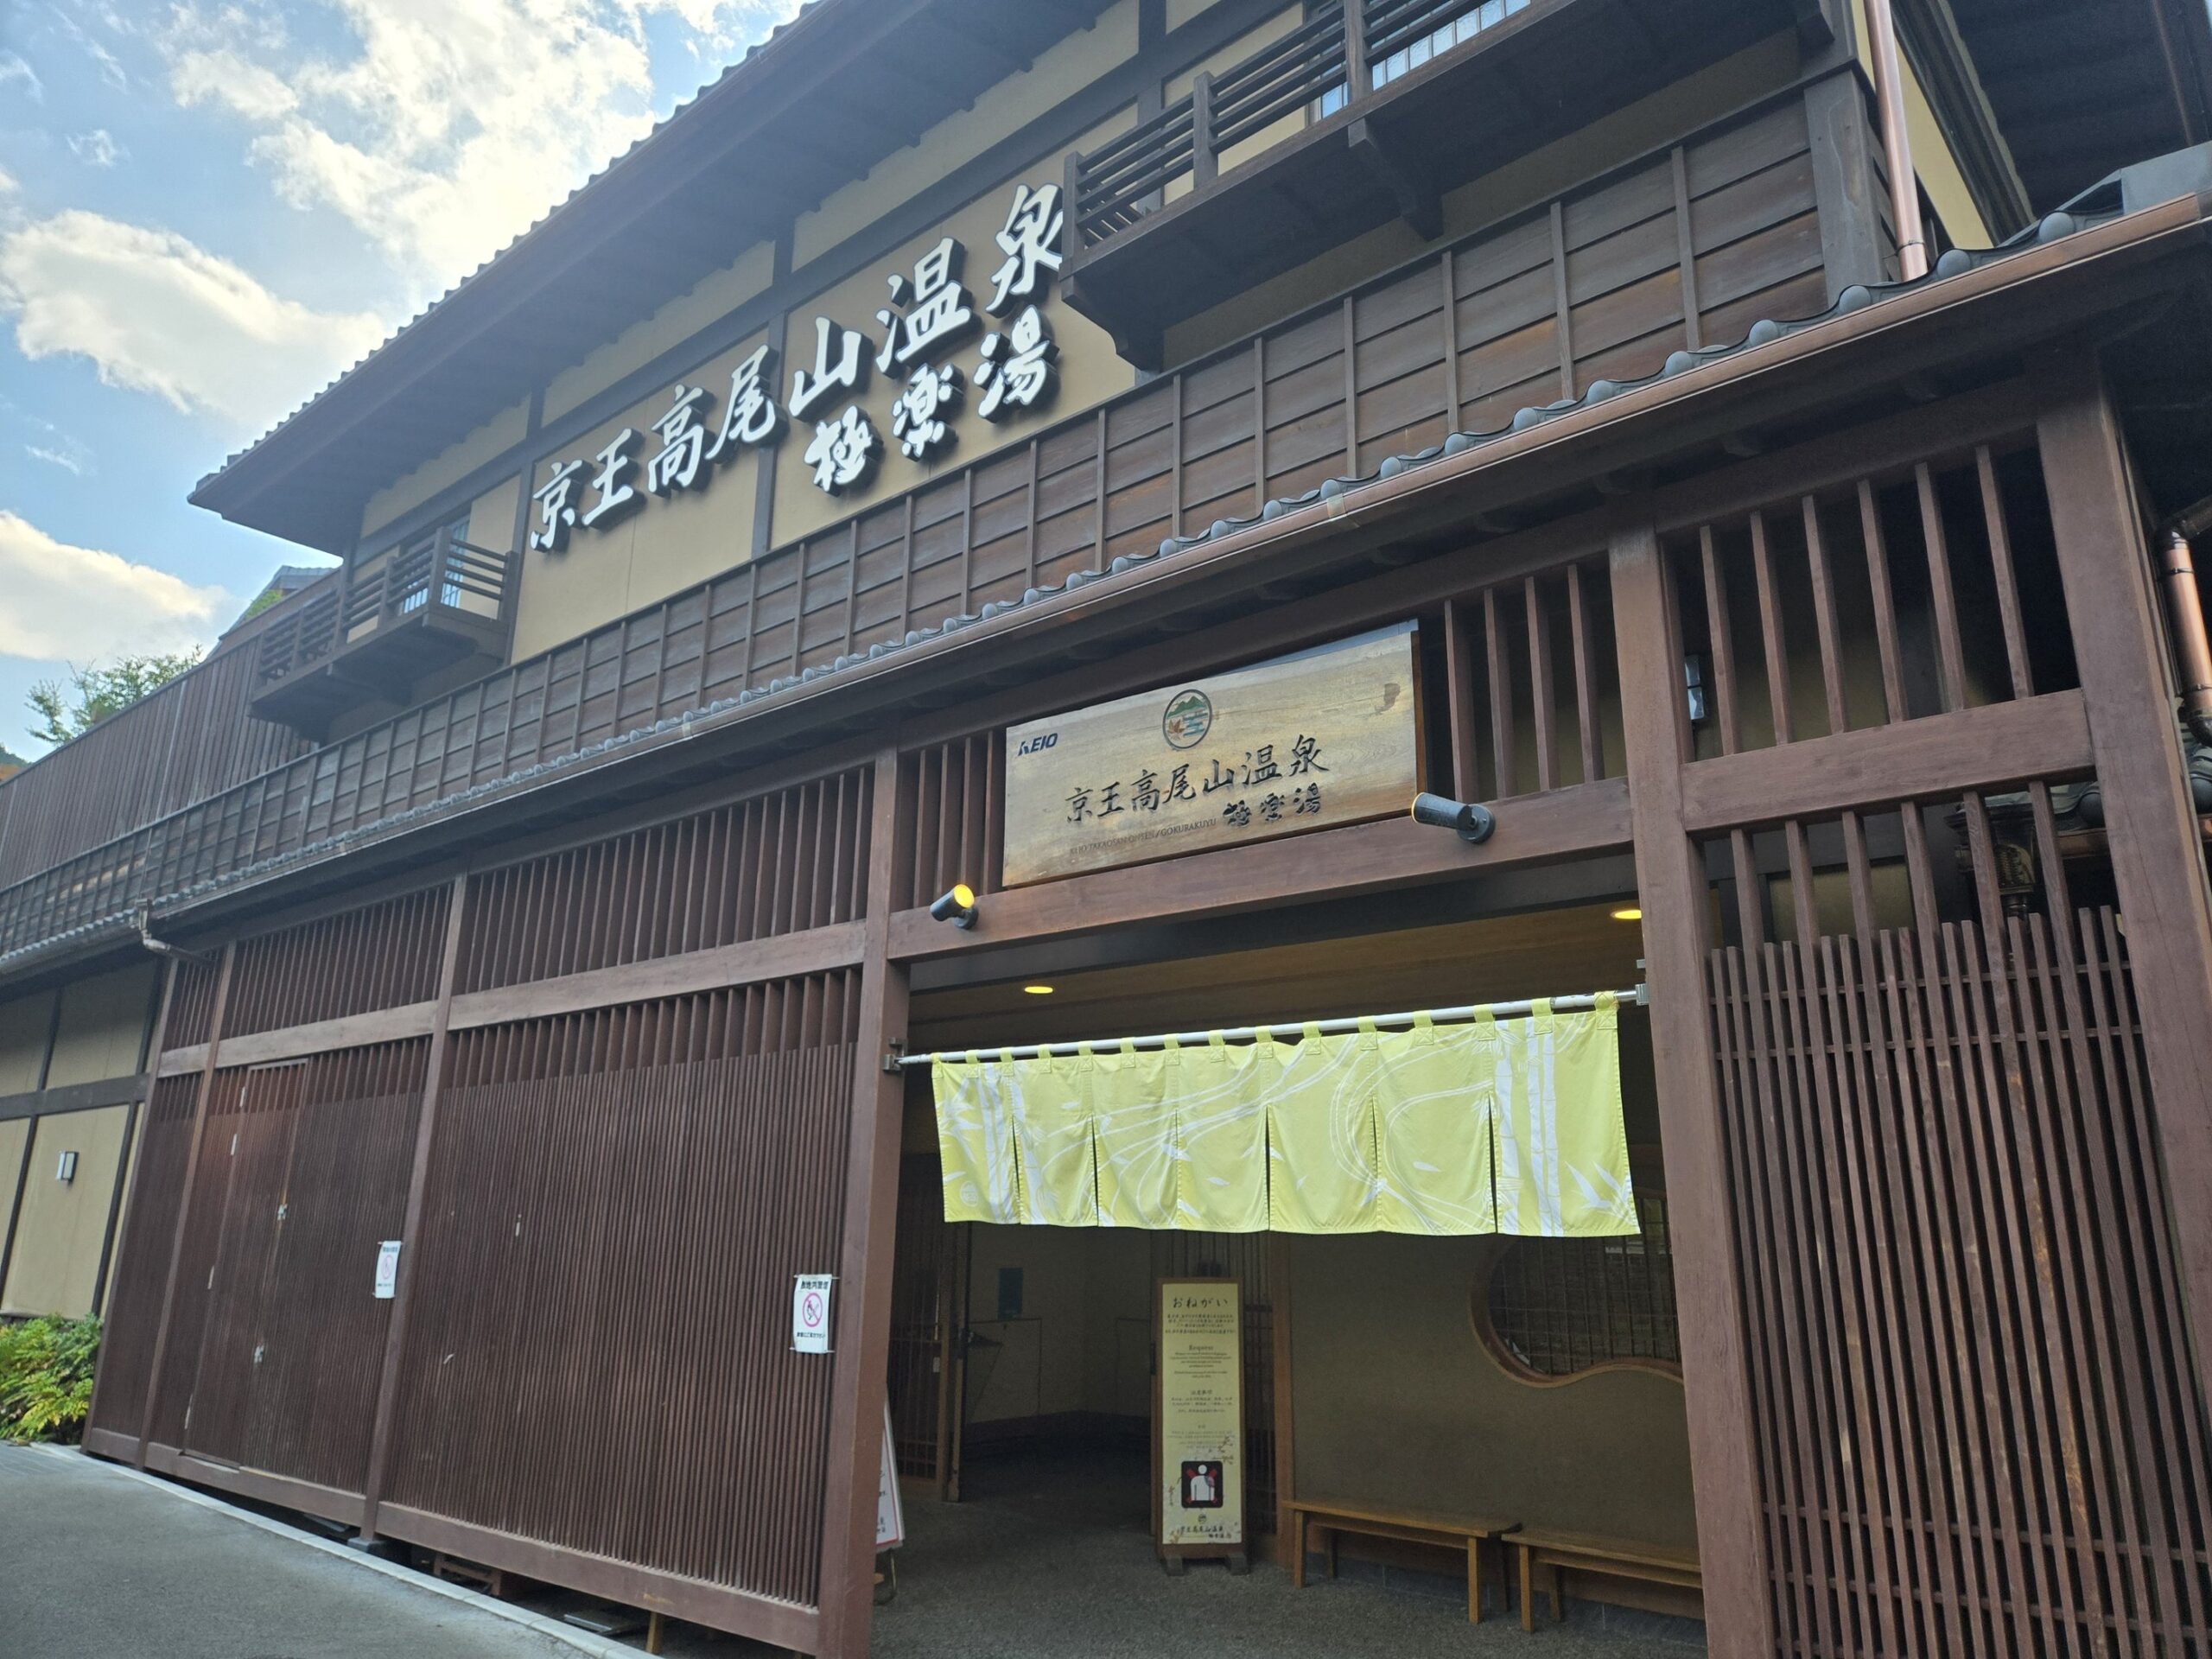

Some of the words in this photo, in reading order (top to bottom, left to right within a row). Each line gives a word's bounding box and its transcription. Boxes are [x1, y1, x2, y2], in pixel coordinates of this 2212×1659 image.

[530, 184, 1063, 551] 京王高尾山温泉
[803, 304, 1050, 493] 極楽湯
[1017, 732, 1058, 757] KEIO
[1065, 734, 1330, 823] 京王高尾山温泉
[1223, 782, 1321, 828] 極楽湯
[1173, 1297, 1229, 1309] おねがい
